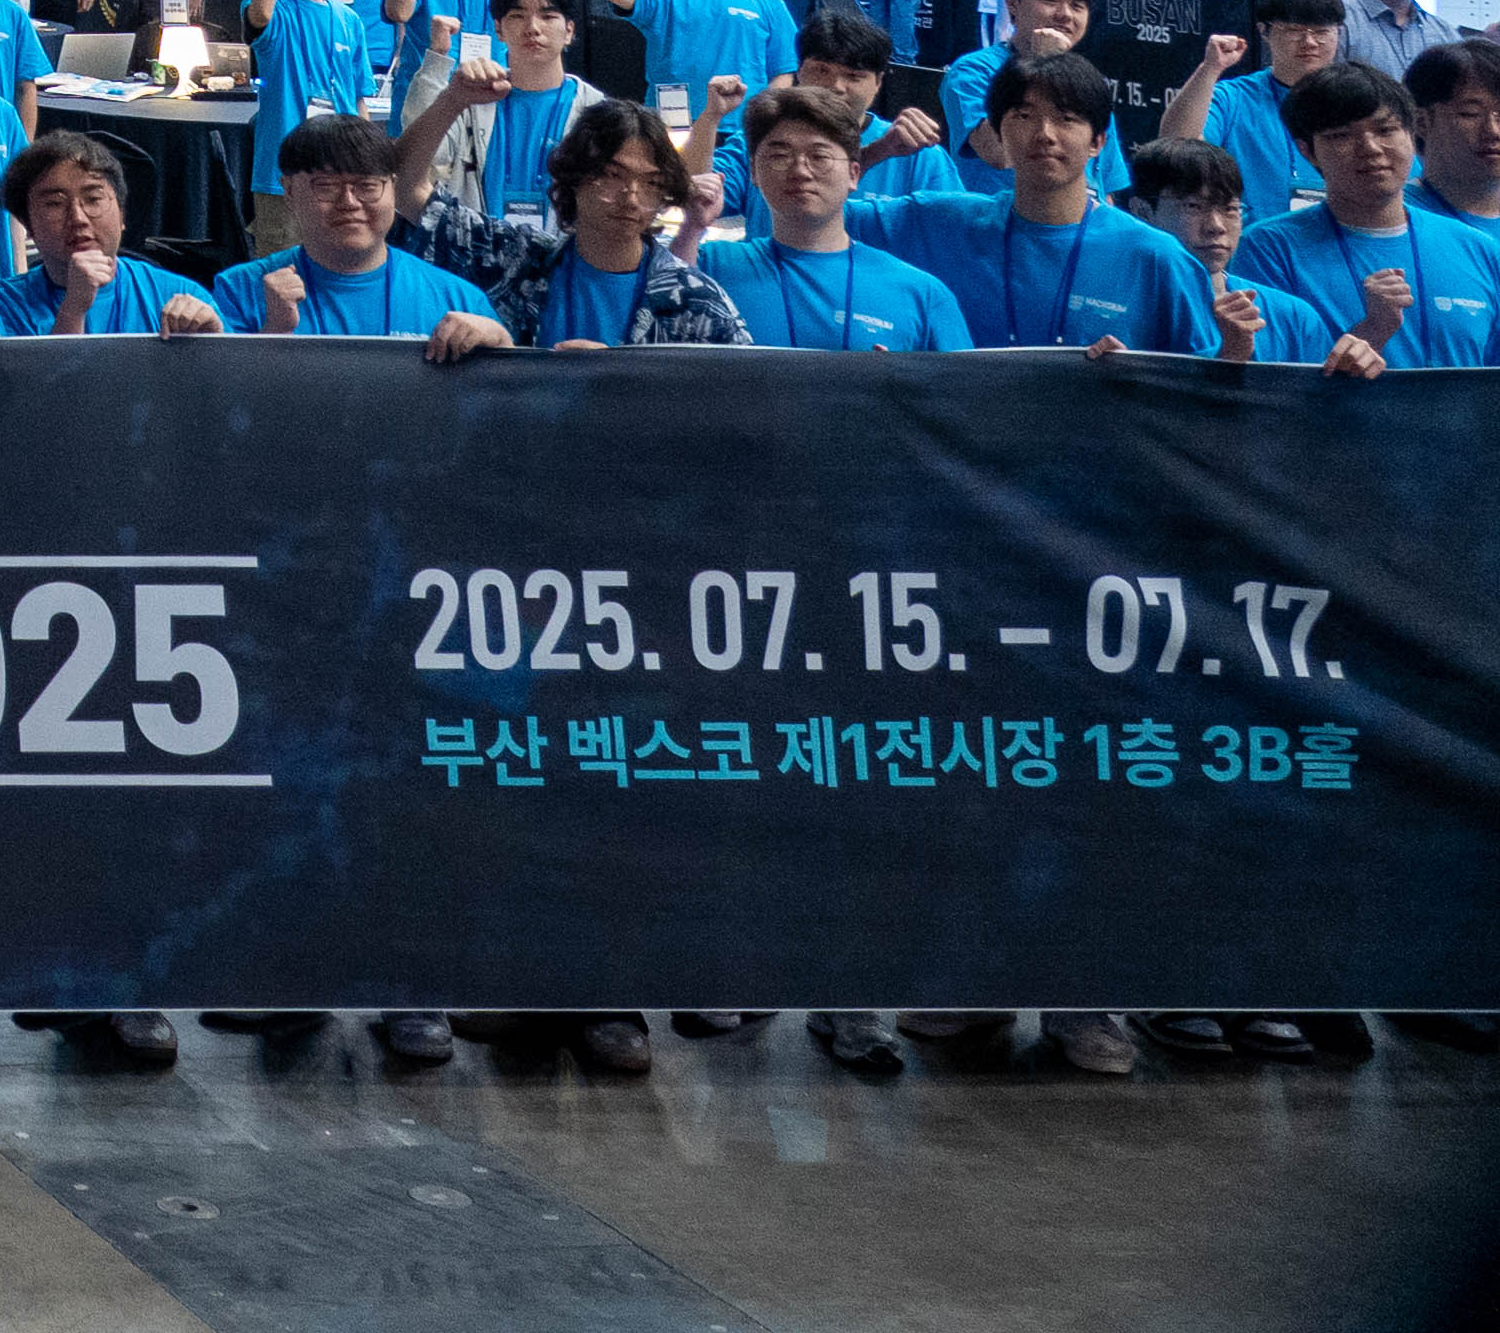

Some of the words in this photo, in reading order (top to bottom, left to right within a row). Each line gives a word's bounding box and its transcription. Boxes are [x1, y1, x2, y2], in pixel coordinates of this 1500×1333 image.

[1136, 23, 1171, 44] 2025
[1126, 82, 1147, 108] 15.
[408, 567, 660, 672] 2025.
[689, 568, 822, 672] 07.
[848, 570, 967, 673] 15.
[1086, 574, 1221, 675] 07.
[1231, 577, 1344, 680] 17.
[420, 718, 547, 789] 부산
[568, 719, 762, 789] 벡스코
[776, 717, 1063, 789] 제1전시장
[1082, 722, 1182, 787] 1층
[1199, 722, 1358, 790] 3B홀
